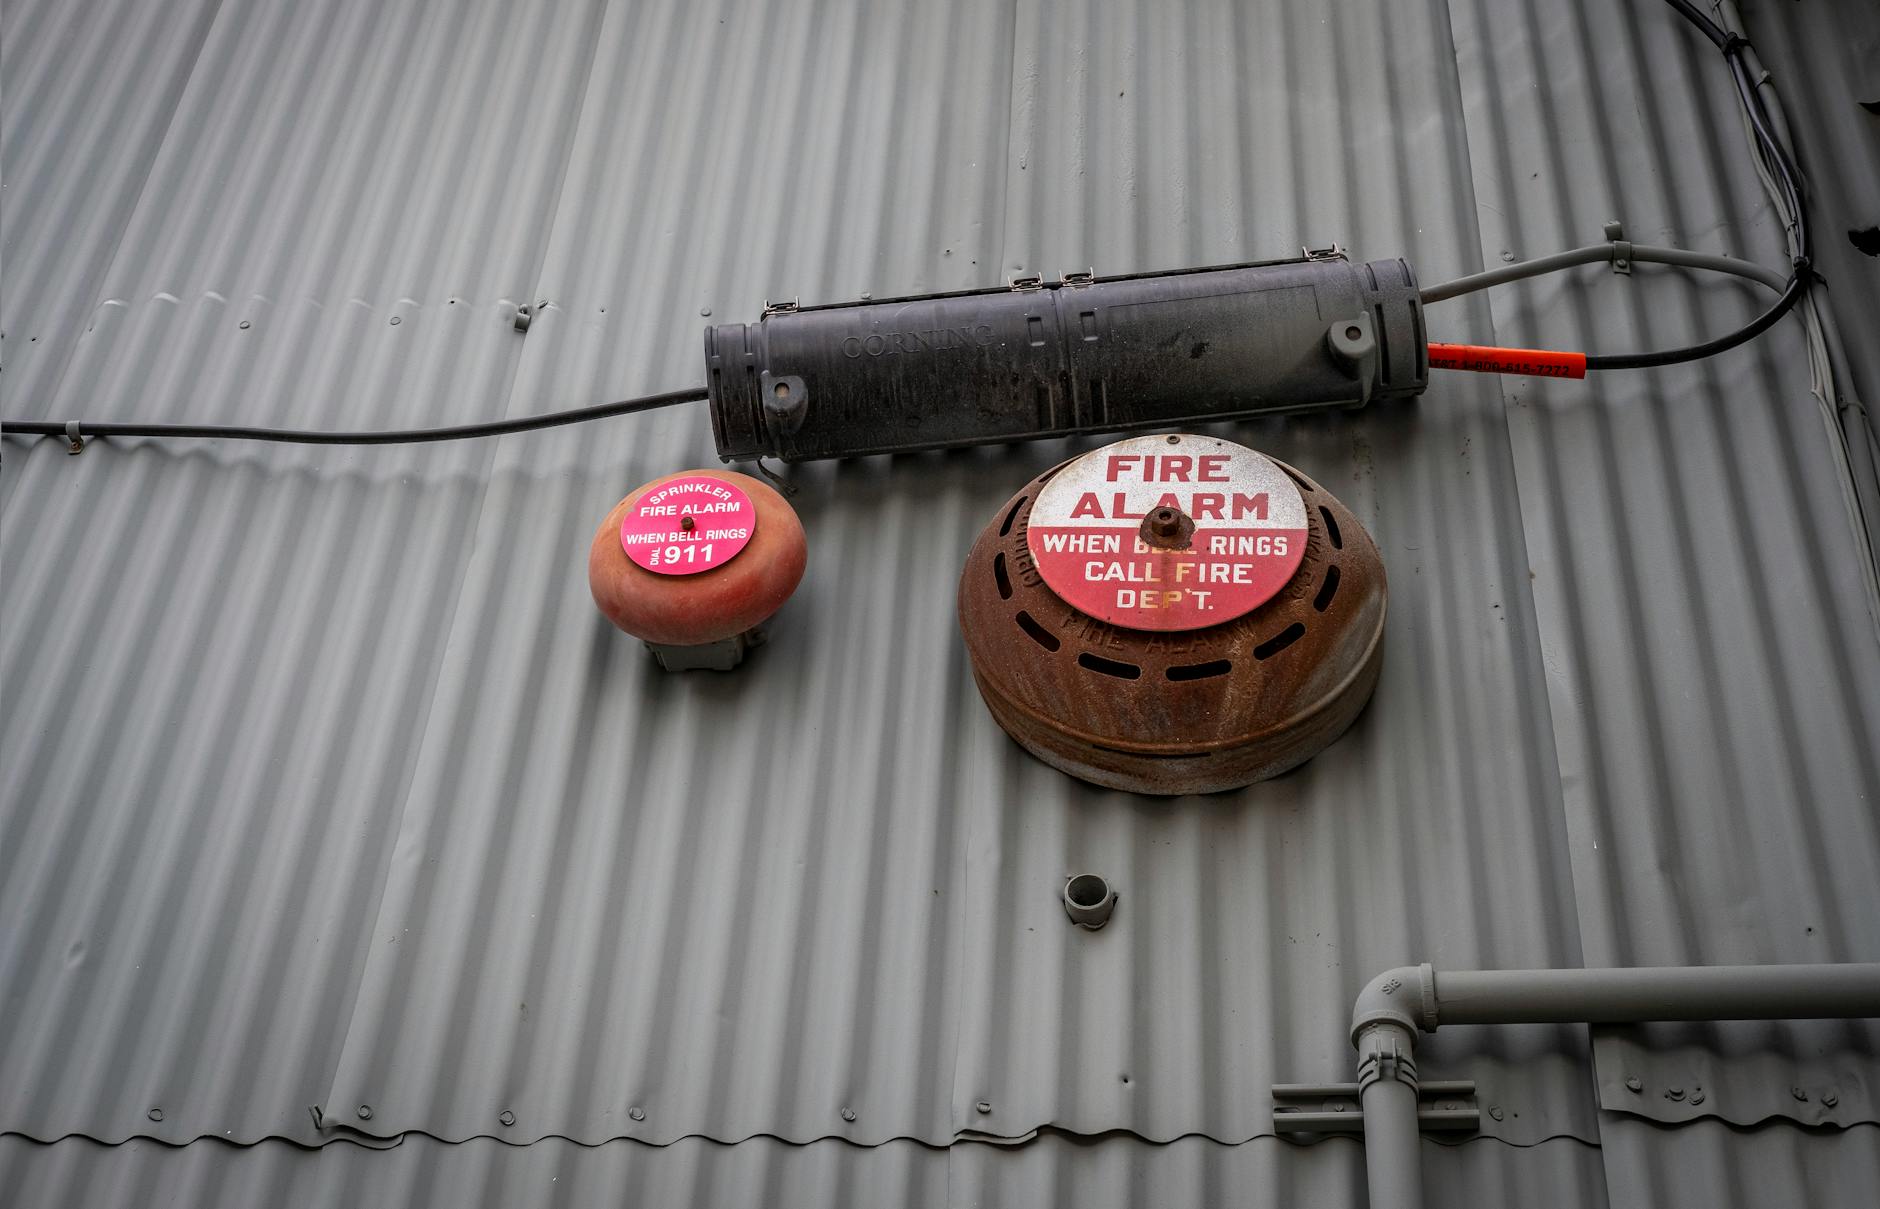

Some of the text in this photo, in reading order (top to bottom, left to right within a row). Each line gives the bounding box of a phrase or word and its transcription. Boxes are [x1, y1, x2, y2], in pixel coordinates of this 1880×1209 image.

[841, 324, 994, 358] CORNING
[1106, 455, 1231, 482] FIRE
[649, 483, 732, 505] SPRINKLER
[640, 502, 740, 517] FIRE ALARM
[1069, 492, 1269, 520] ALARM
[626, 528, 747, 545] WHEN BELL RINGS
[1043, 534, 1120, 554] WHEN
[1211, 536, 1288, 556] RINGS
[650, 547, 661, 565] DIAL
[664, 544, 713, 564] 911
[1085, 561, 1253, 584] CALL FIRE
